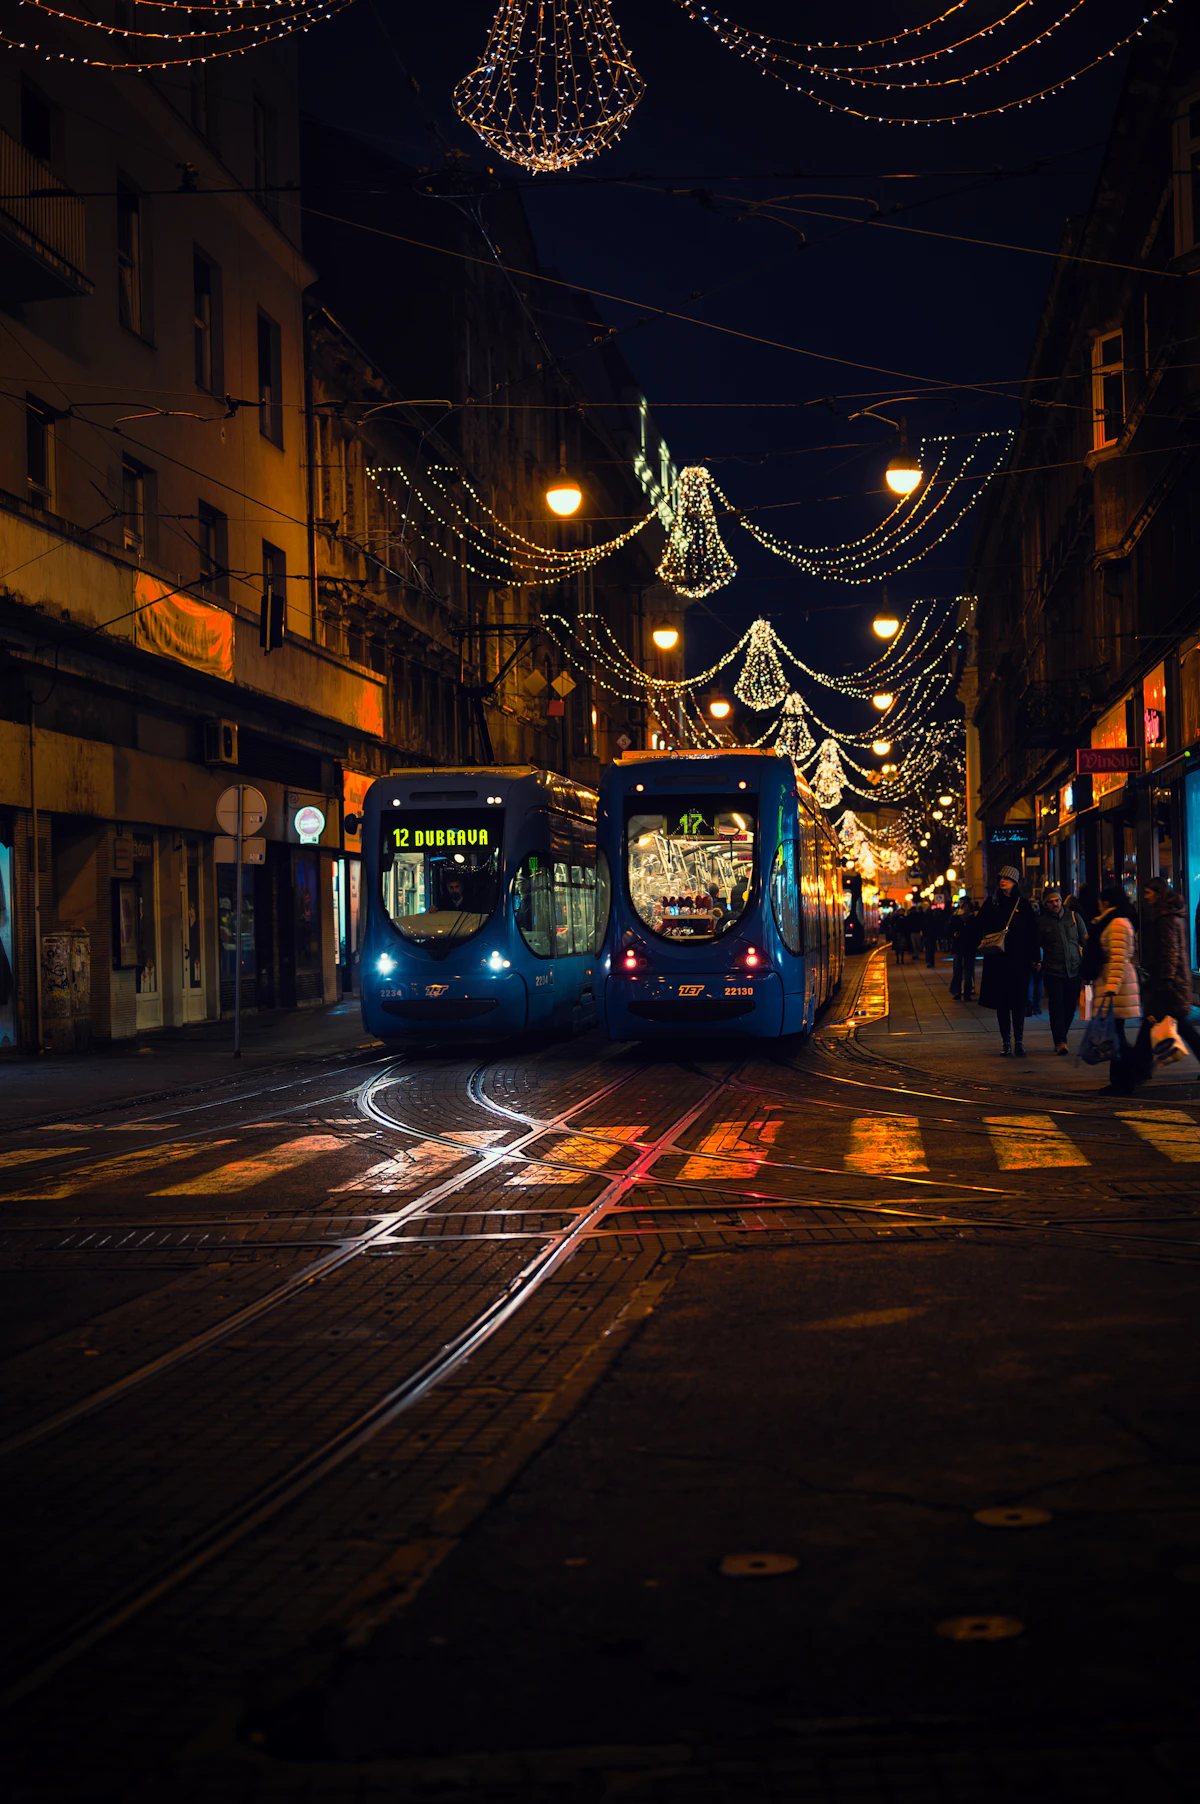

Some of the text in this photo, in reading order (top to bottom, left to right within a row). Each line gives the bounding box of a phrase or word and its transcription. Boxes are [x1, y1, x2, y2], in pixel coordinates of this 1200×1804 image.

[1082, 752, 1139, 769] Vindija
[679, 813, 703, 835] 17
[392, 828, 489, 847] 12 DUBRAVA
[535, 974, 549, 987] 2234
[380, 989, 402, 997] 2234
[678, 984, 705, 996] ZET
[724, 987, 754, 996] 22130
